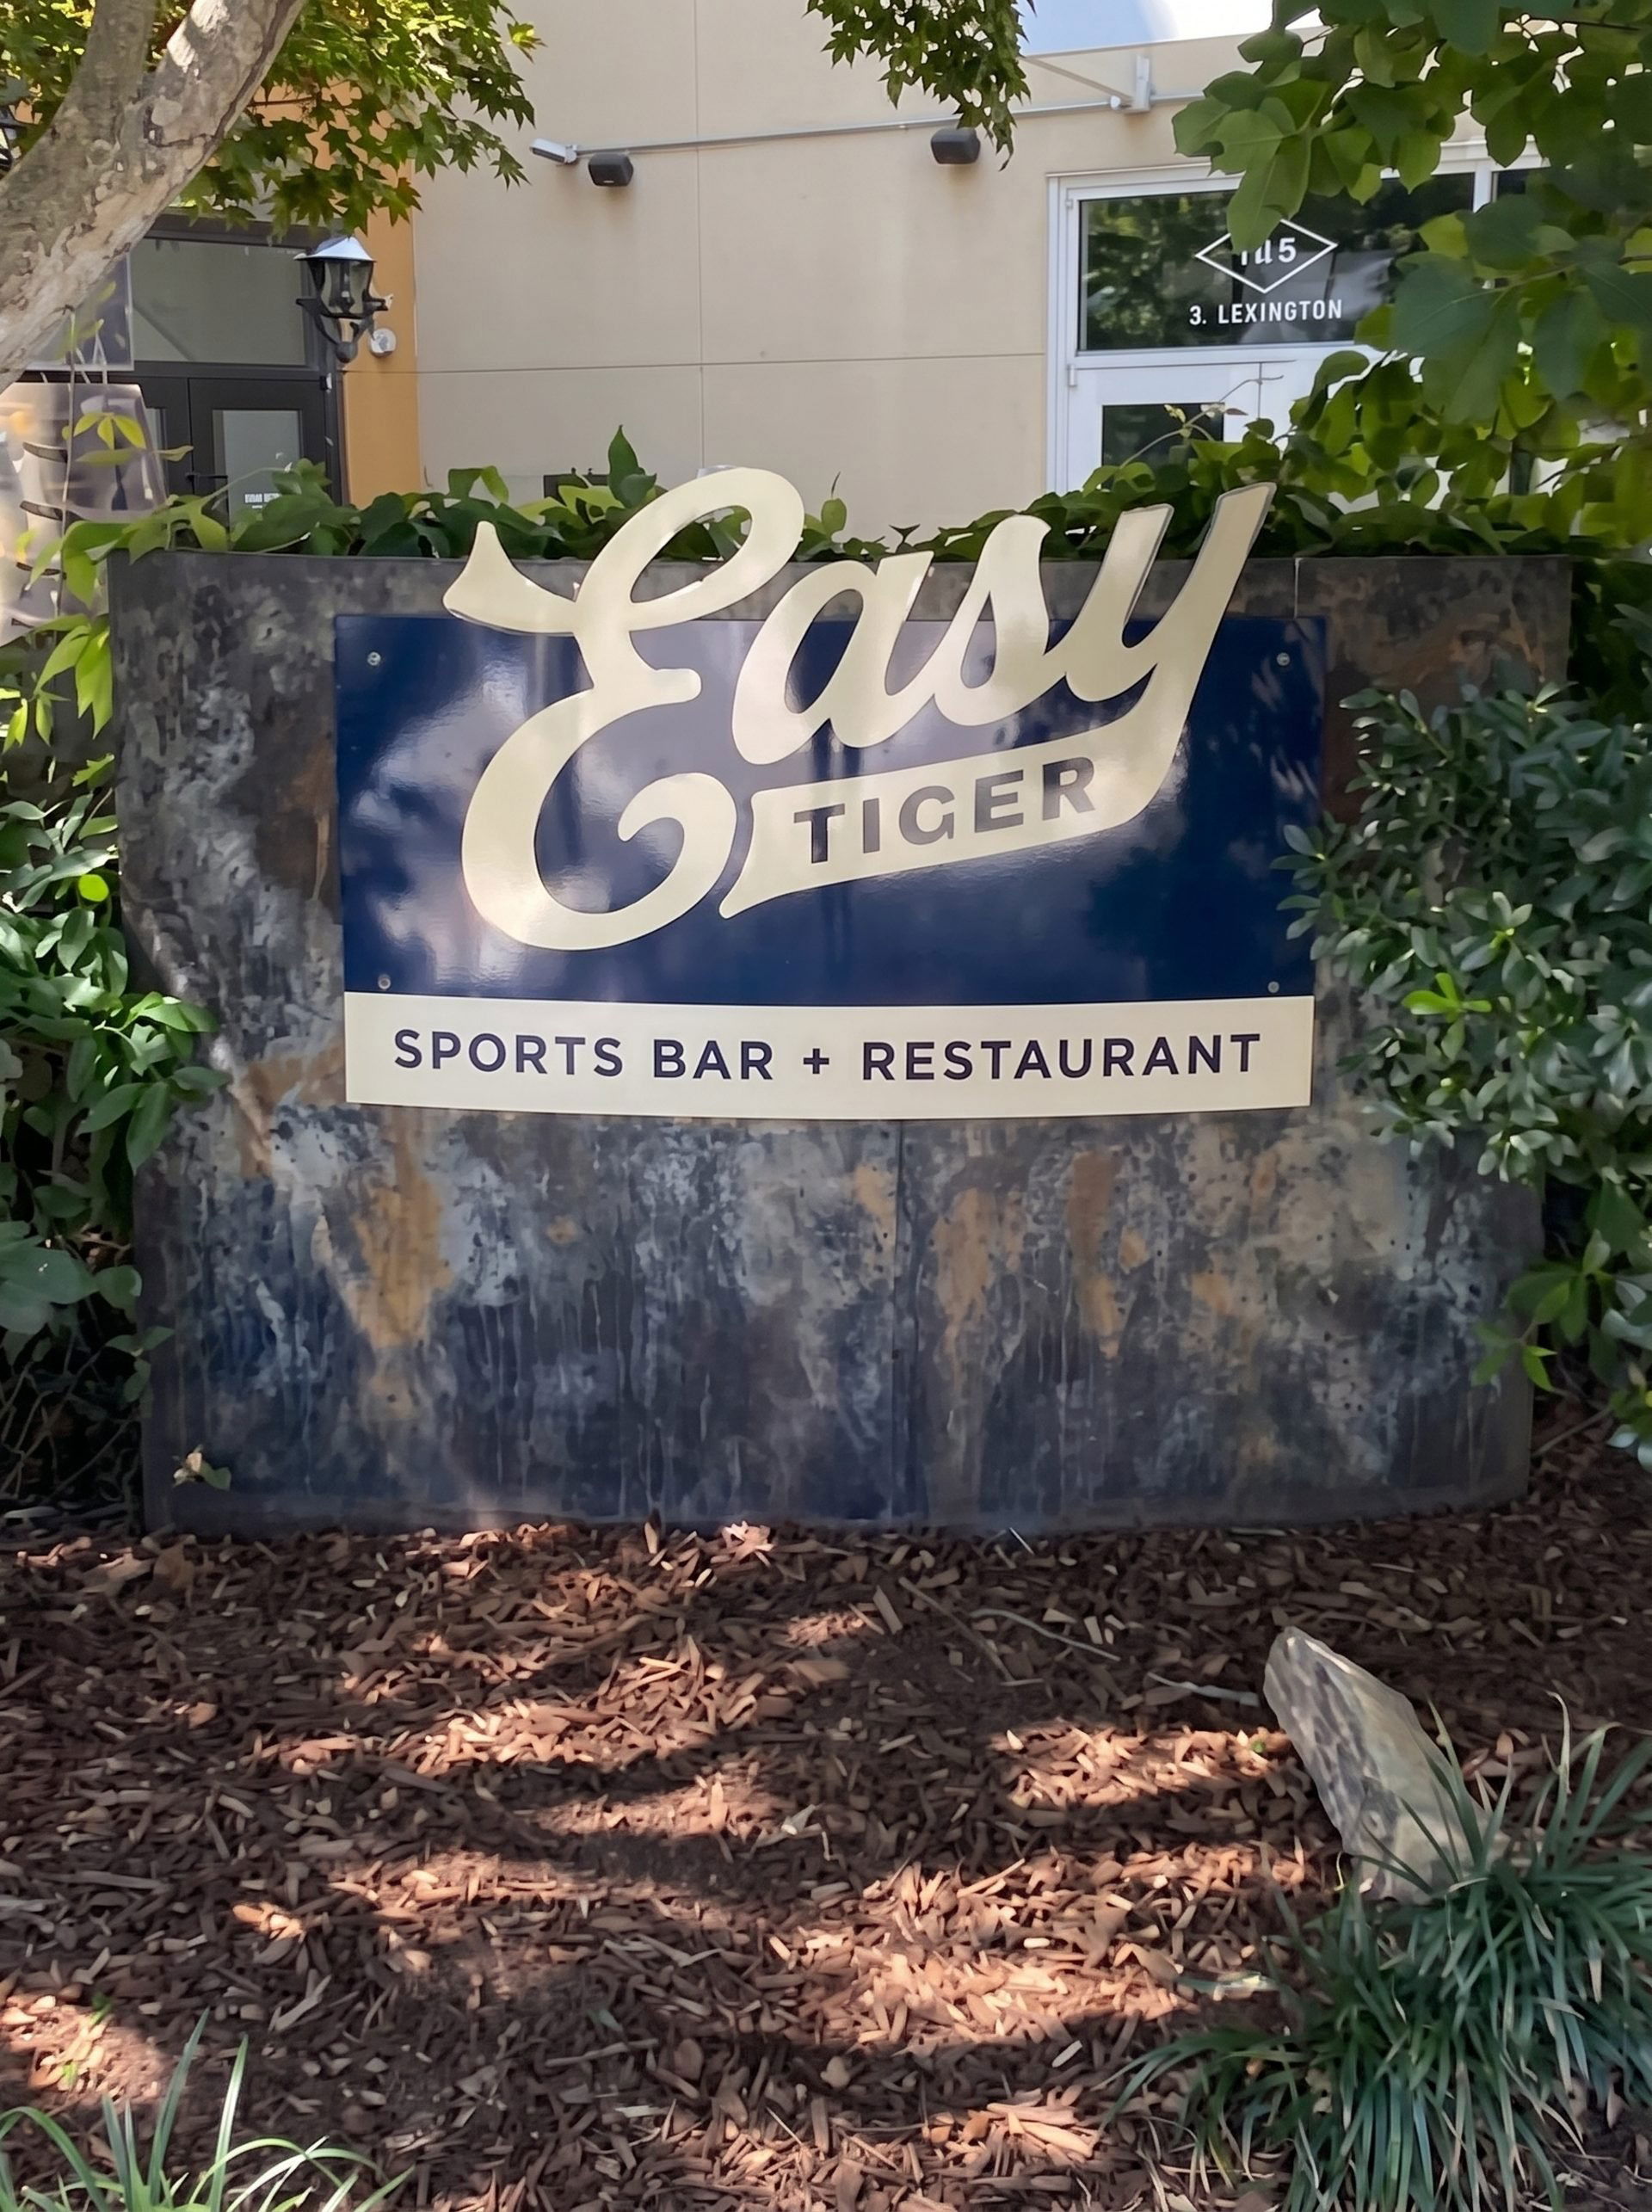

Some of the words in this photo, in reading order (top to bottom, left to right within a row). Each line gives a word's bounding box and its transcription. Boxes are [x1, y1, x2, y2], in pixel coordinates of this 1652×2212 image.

[1188, 305, 1207, 325] 3.
[1217, 299, 1342, 324] LEXINGTON
[442, 465, 1277, 952] Easy
[792, 755, 1097, 864] TIGER
[393, 1028, 624, 1077] SPORTS
[653, 1038, 774, 1081] BAR
[802, 1047, 830, 1075] +
[861, 1032, 1261, 1081] RESTAURANT
